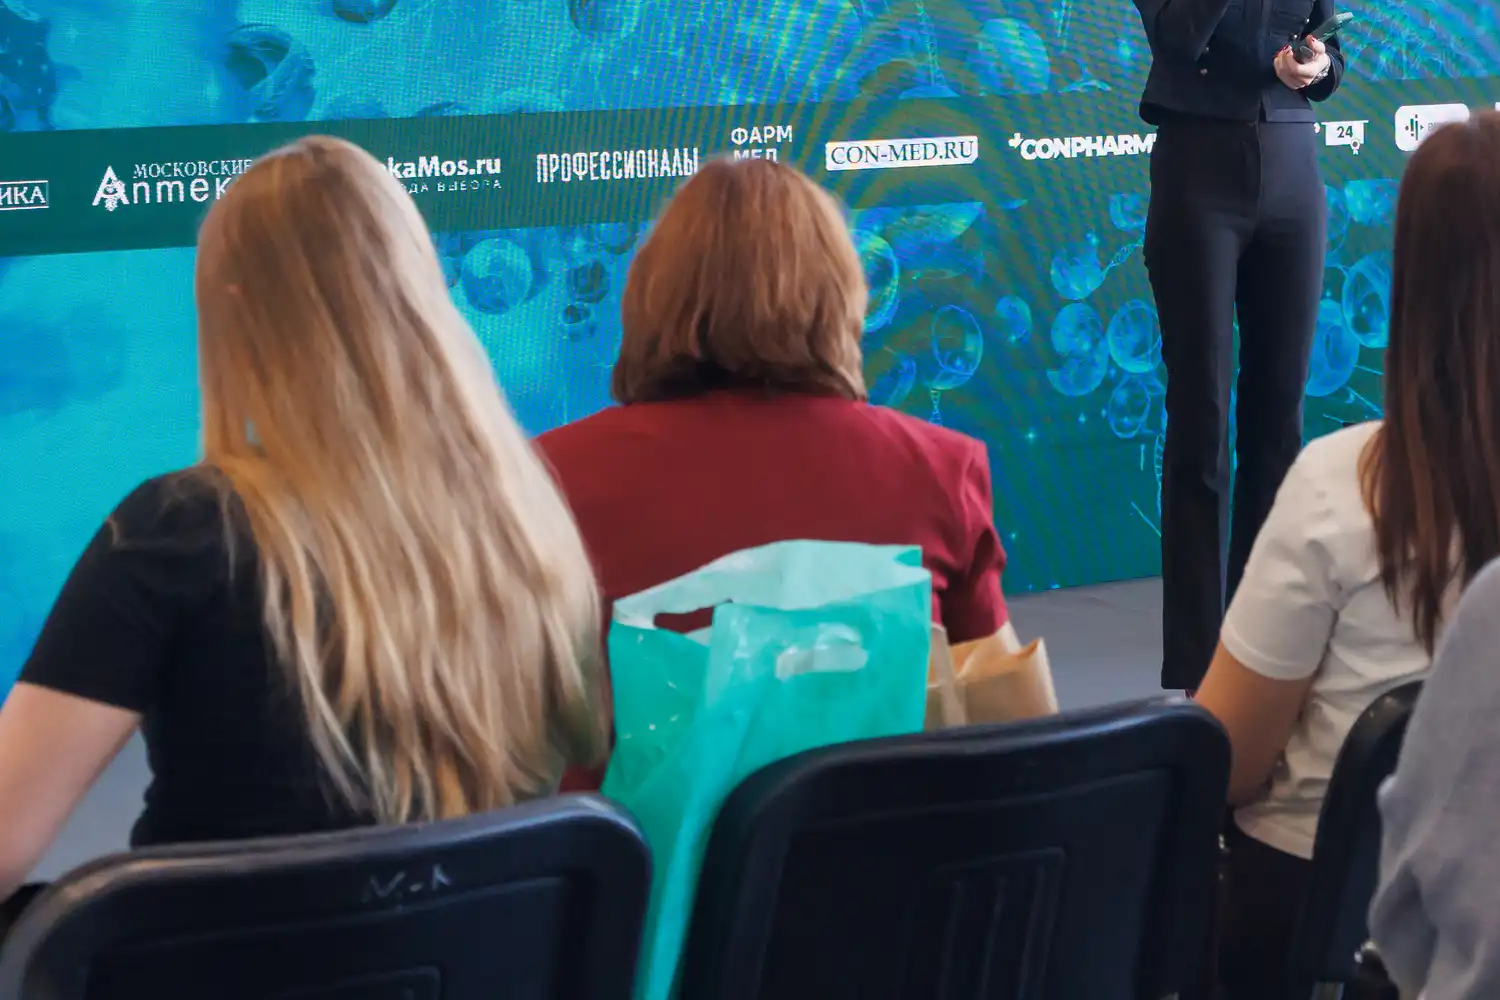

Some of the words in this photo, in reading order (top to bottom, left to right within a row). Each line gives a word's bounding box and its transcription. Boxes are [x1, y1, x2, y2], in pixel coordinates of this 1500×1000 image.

[731, 125, 793, 145] ФАРМ
[1336, 125, 1354, 139] 24
[830, 140, 975, 166] CON-MED.RU
[1020, 133, 1157, 161] CONPHARM
[380, 155, 501, 179] kaMos.ru
[536, 147, 699, 183] ПРОФЕССИОНАЛЫ
